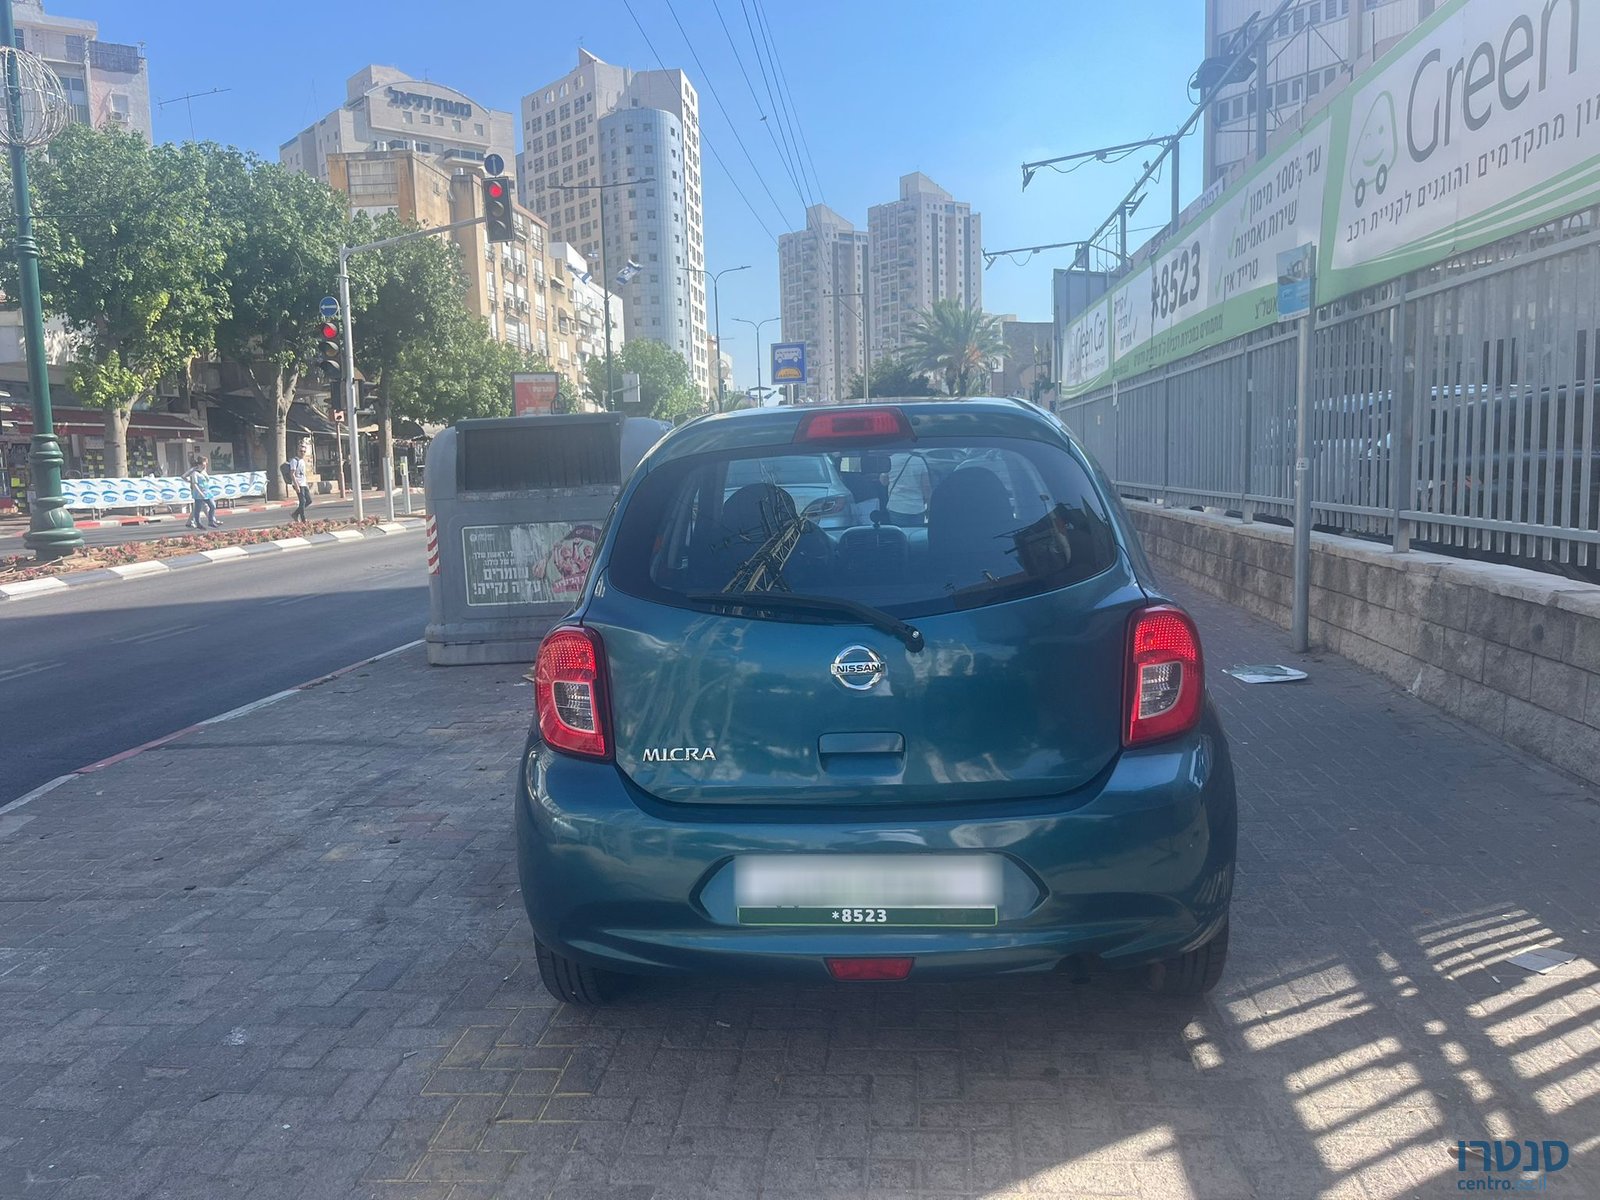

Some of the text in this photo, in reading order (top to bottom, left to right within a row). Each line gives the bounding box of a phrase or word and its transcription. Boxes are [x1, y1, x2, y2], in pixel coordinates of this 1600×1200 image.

[1406, 0, 1580, 163] Green
[1477, 113, 1565, 178] מתקדמים
[1249, 145, 1322, 224] עד 100% מימון
[1417, 162, 1470, 208] והוגנים
[1234, 199, 1298, 259] שירות ואמינות
[1346, 218, 1367, 243] רכב
[1369, 189, 1412, 232] לקניית
[1223, 257, 1259, 301] טרייד אין
[472, 581, 509, 597] נקייה!
[483, 566, 529, 581] שומרים
[836, 663, 880, 673] NISSAN
[642, 746, 717, 762] MICRA
